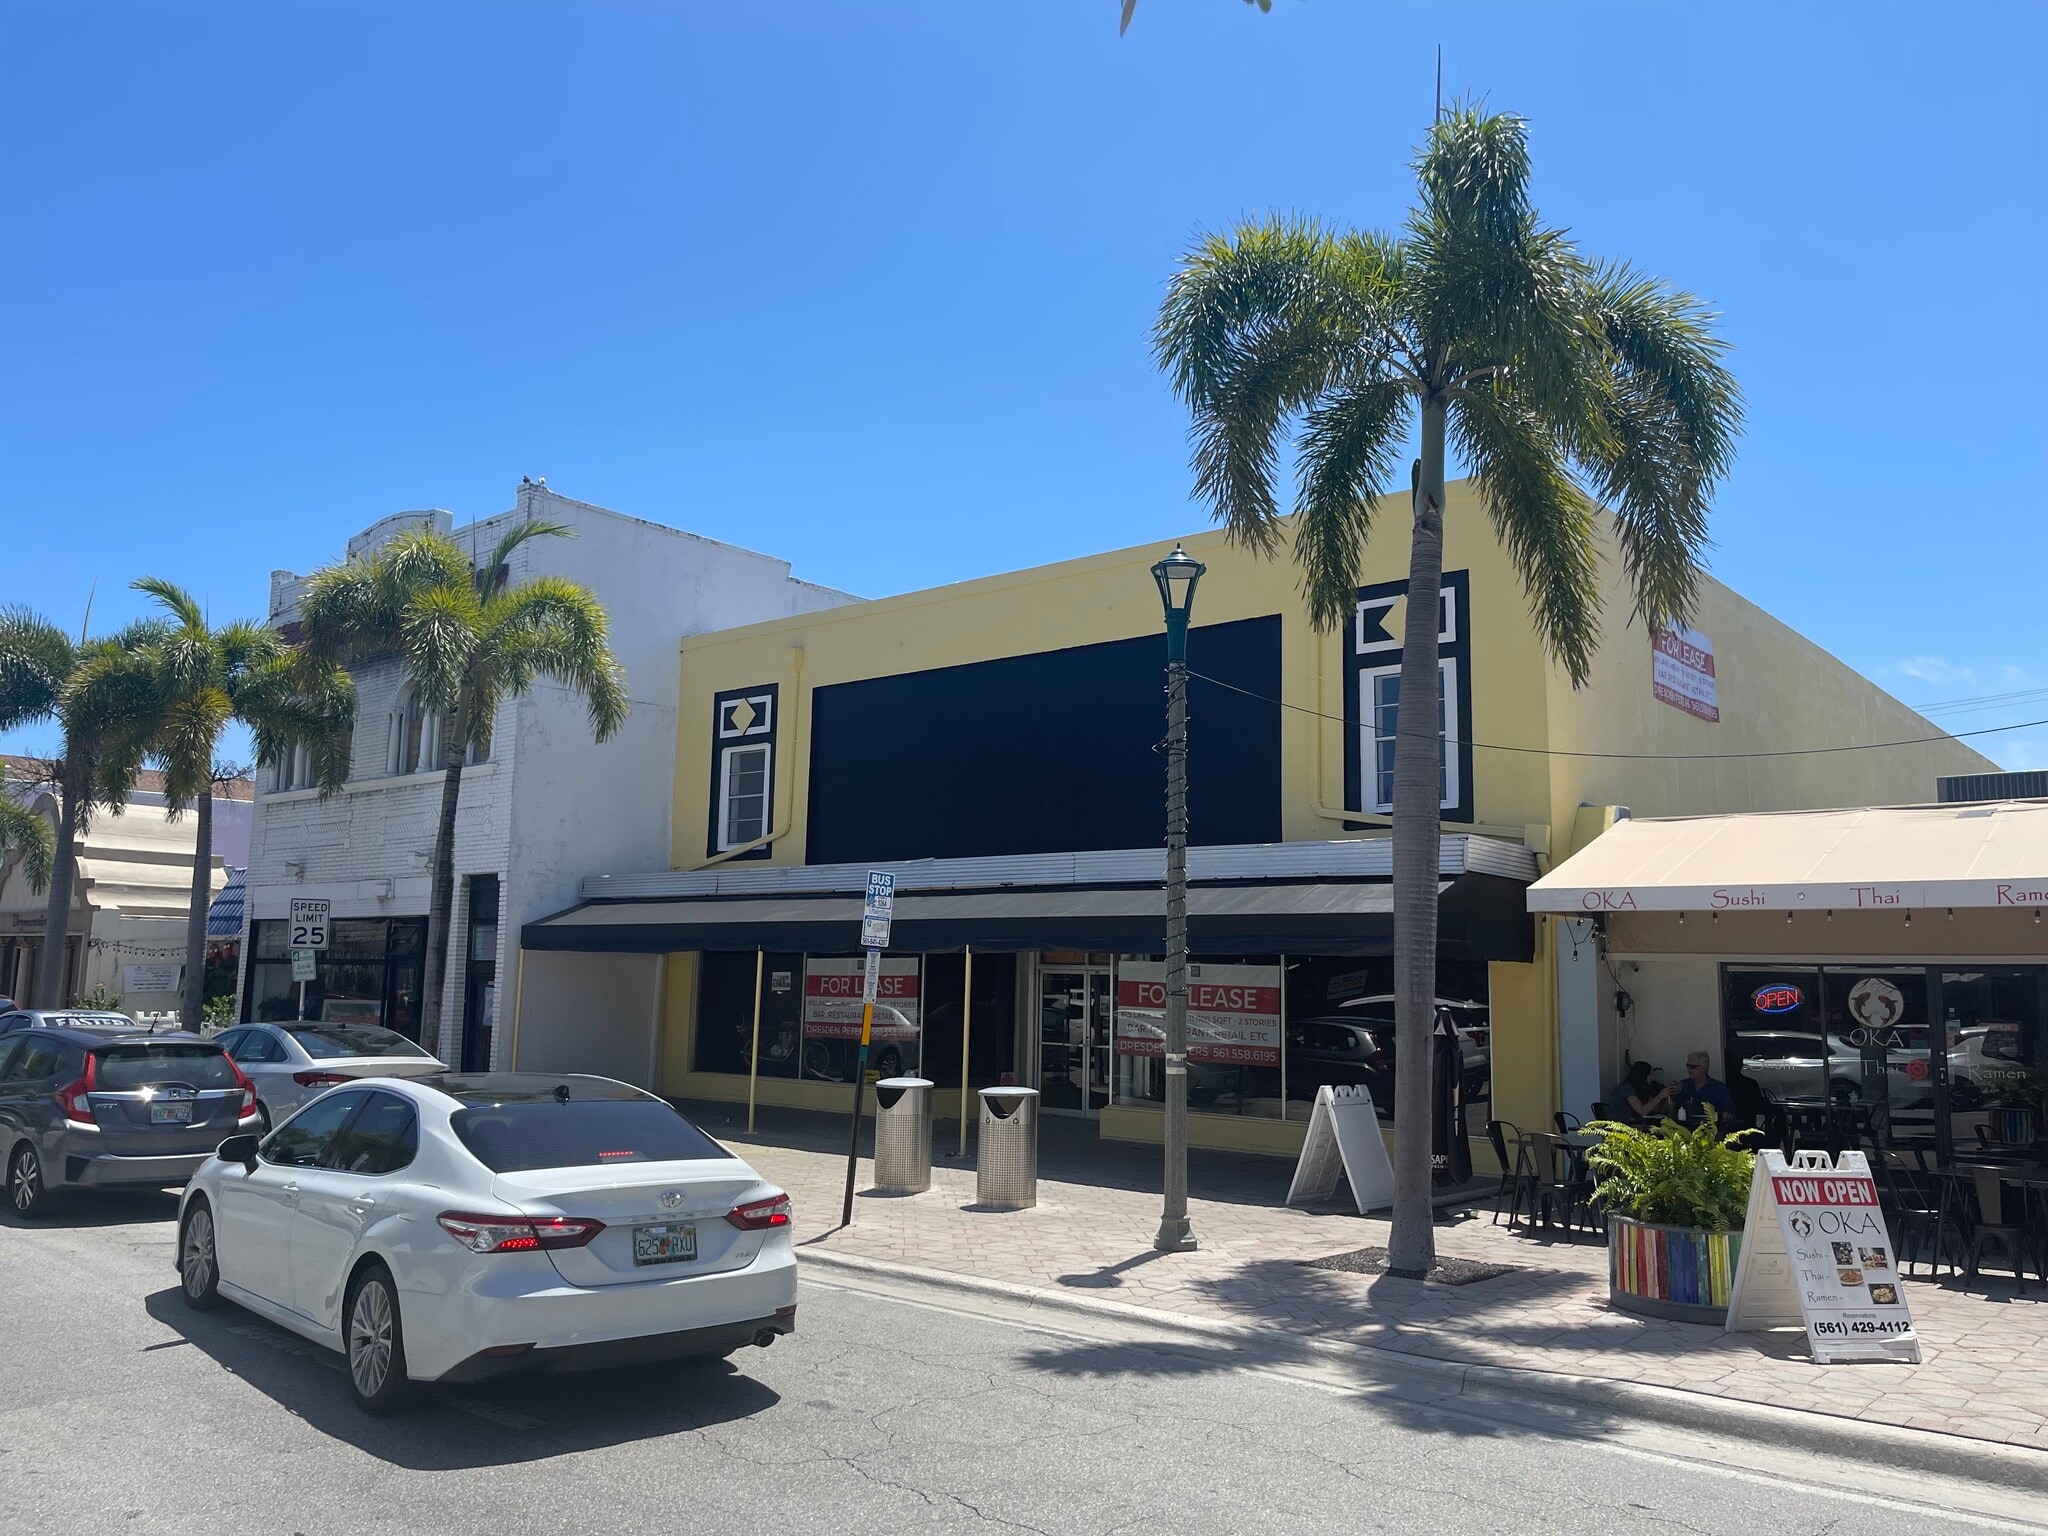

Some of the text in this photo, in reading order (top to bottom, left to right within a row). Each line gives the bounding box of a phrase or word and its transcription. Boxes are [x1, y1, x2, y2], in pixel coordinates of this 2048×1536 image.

[1661, 632, 1679, 660] FOR
[1679, 641, 1707, 672] LEASE
[871, 873, 891, 886] BUS
[868, 884, 892, 897] STOP
[1582, 891, 1637, 910] OKA
[1710, 888, 1765, 909] Sushi
[1849, 886, 1900, 908] Thai
[293, 902, 328, 912] SPEED
[295, 913, 324, 923] LIMIT
[292, 926, 325, 945] 25
[820, 977, 904, 995] FOR LASE
[1138, 983, 1257, 1010] FO LEASE
[1755, 989, 1799, 1010] OPEN
[1211, 1016, 1232, 1026] SQFT
[1244, 1018, 1277, 1028] STORIES
[806, 1025, 841, 1035] DRESDEN
[1250, 1032, 1269, 1042] ETC
[1850, 1027, 1904, 1047] OKA
[1213, 1048, 1276, 1062] 561.558.6195
[1859, 1059, 1900, 1076] Thai
[1968, 1064, 2026, 1081] Ramen
[1778, 1179, 1873, 1204] NOW OPEN
[1818, 1210, 1881, 1235] OKA
[638, 1239, 659, 1257] 625
[1796, 1248, 1824, 1260] Sushi
[1800, 1269, 1825, 1282] Thai
[1806, 1291, 1838, 1304] Ramen
[1842, 1312, 1877, 1320] Reservations
[1813, 1321, 1911, 1337] (561) 429-4112
